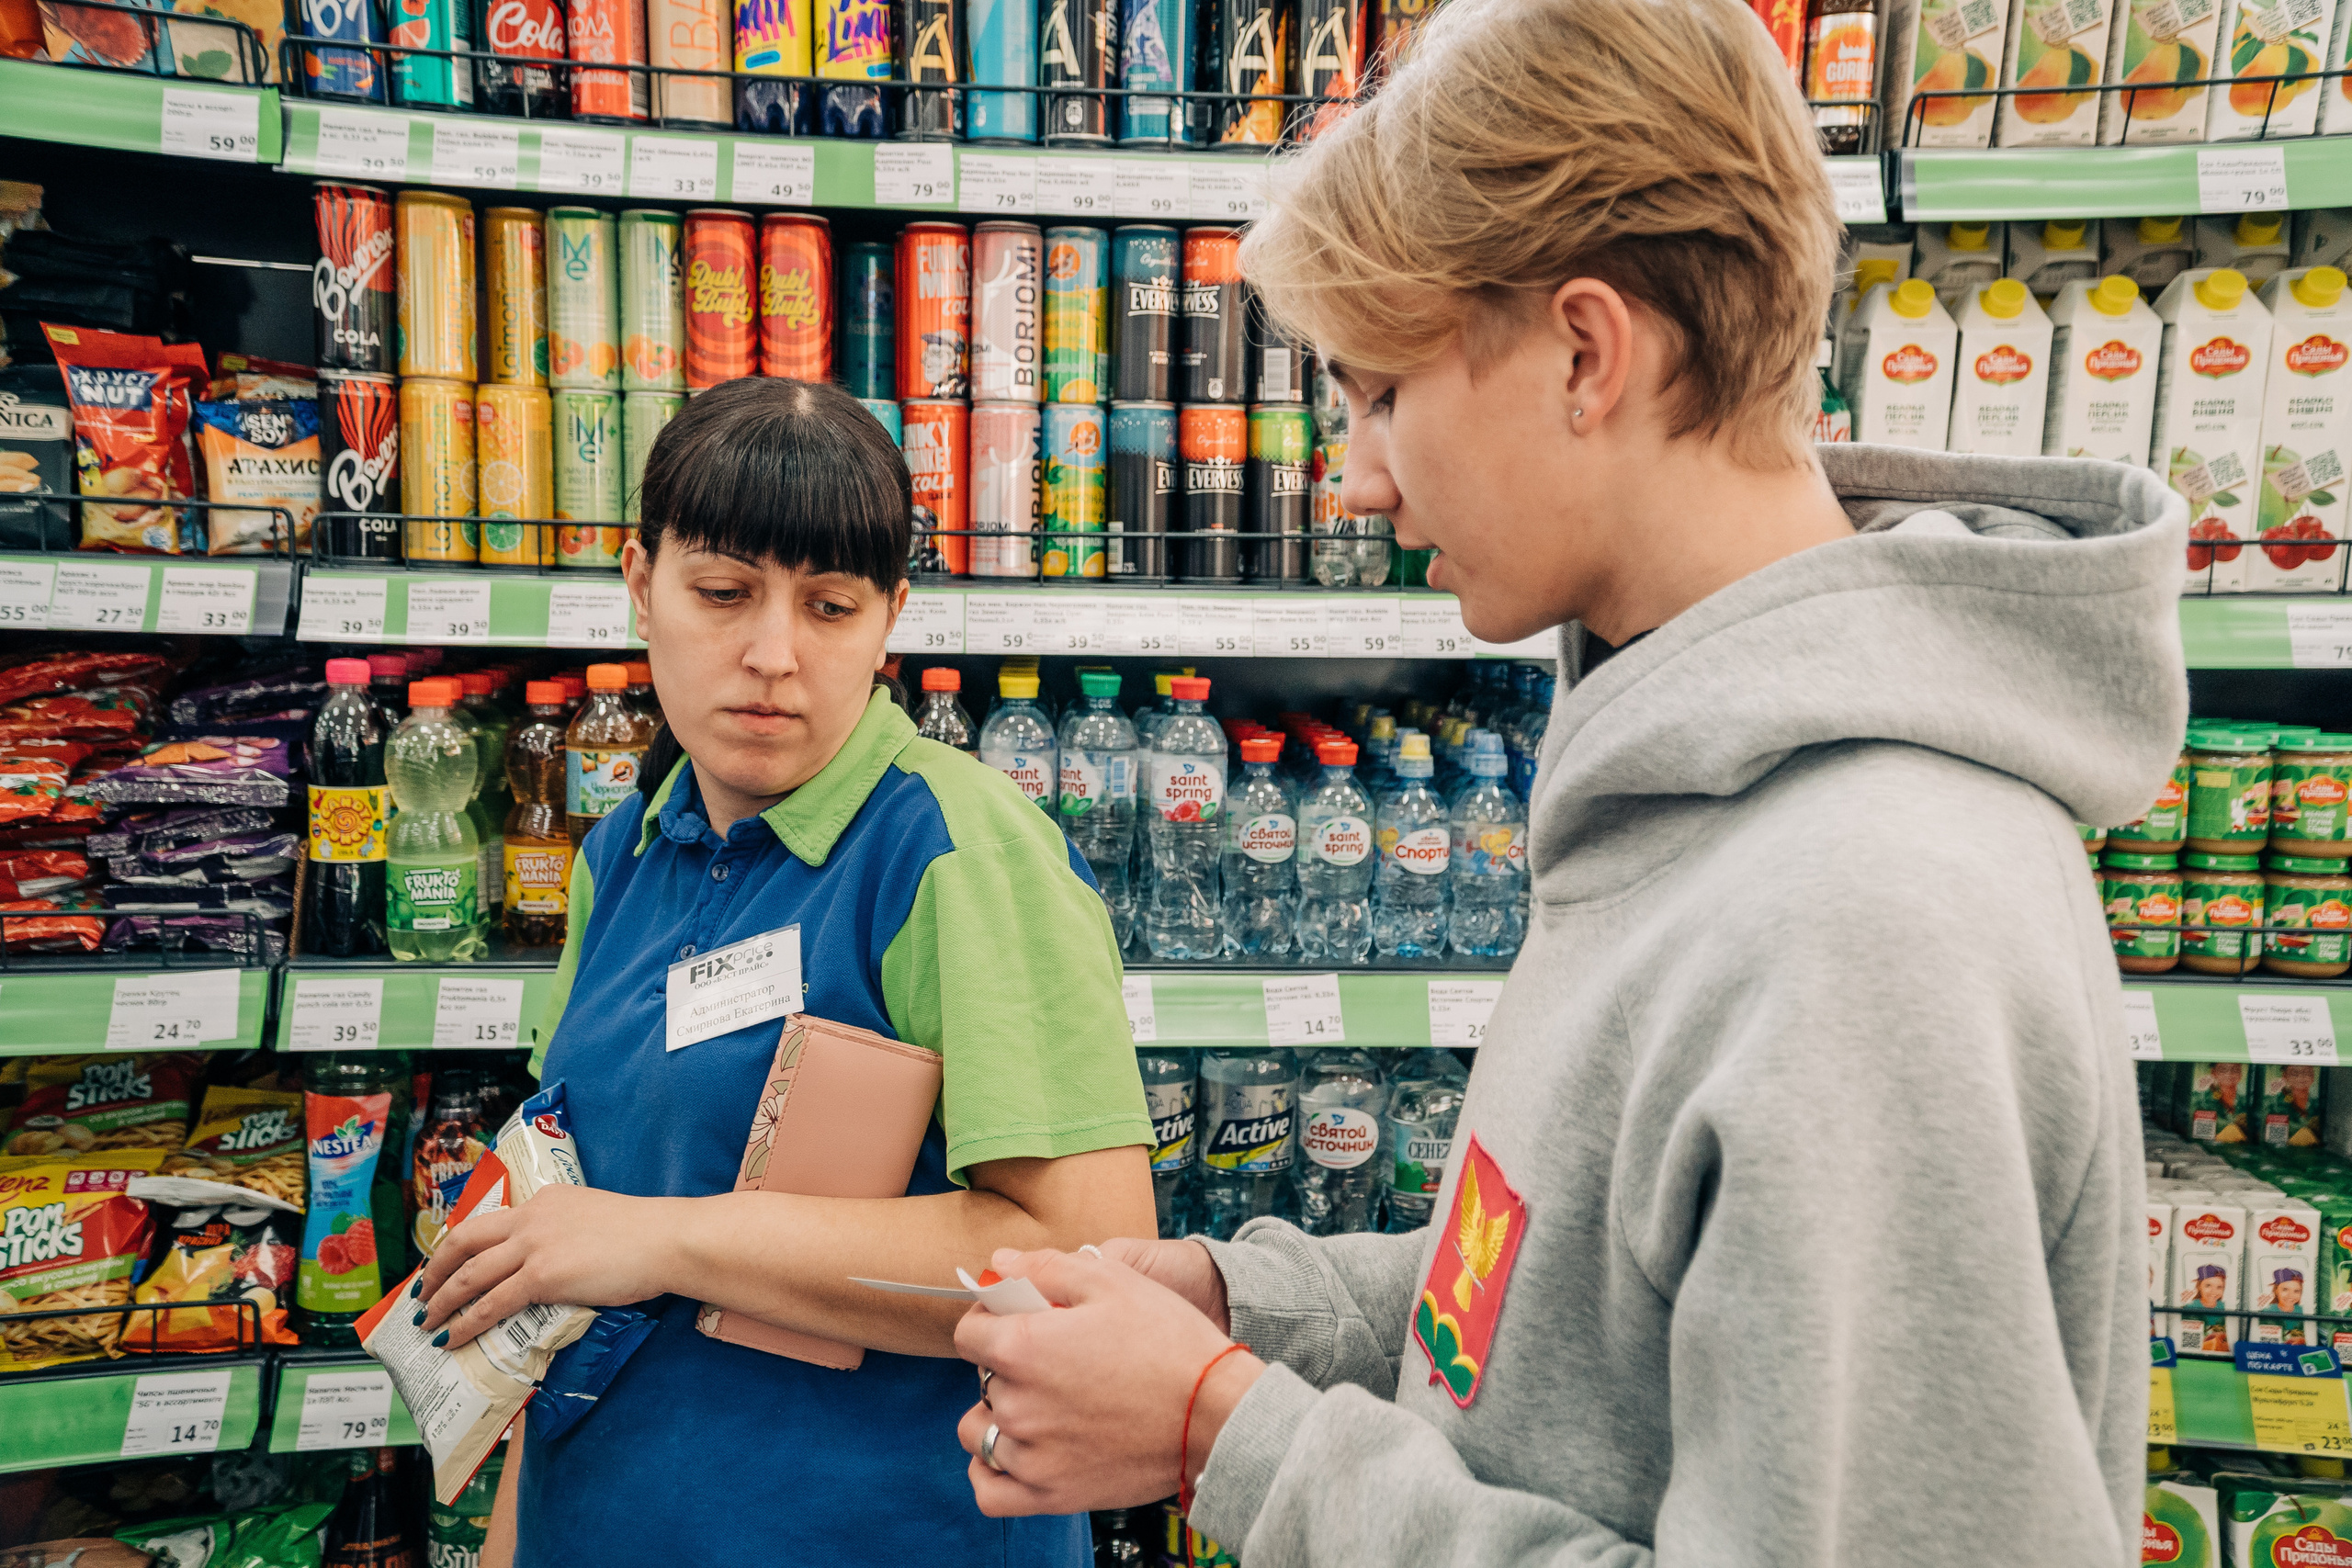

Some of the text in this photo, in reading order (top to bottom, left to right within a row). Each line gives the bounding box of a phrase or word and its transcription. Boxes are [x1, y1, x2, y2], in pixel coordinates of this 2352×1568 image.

[490, 1, 563, 51] Cola
[210, 136, 235, 152] 59
[473, 166, 497, 180] 59
[580, 173, 602, 188] 39
[673, 179, 695, 193] 33
[771, 184, 793, 197] 49
[912, 184, 933, 197] 79
[996, 194, 1016, 207] 79
[1073, 196, 1093, 209] 99
[1151, 198, 1172, 211] 99
[2242, 189, 2266, 205] 79
[1228, 200, 1249, 213] 99
[1014, 244, 1036, 388] BORJOMI
[333, 328, 381, 347] COLA
[79, 384, 144, 406] NUT
[247, 412, 288, 430] SEN
[250, 426, 287, 447] SOY
[1187, 465, 1244, 491] EVERVESS
[358, 518, 397, 534] COLA
[96, 606, 143, 625] 27 50
[202, 610, 248, 627] 33 00
[339, 620, 363, 635] 39
[447, 623, 469, 636] 39
[924, 633, 945, 647] 39
[1002, 634, 1023, 648] 59
[1068, 636, 1088, 649] 39
[1140, 637, 1161, 650] 55
[1216, 637, 1236, 650] 55
[1290, 635, 1327, 650] 55 00
[1364, 637, 1385, 650] 59
[1435, 638, 1456, 652] 39
[1170, 773, 1208, 787] saint
[1165, 785, 1213, 801] spring
[1329, 831, 1361, 842] saint
[1325, 841, 1364, 856] spring
[514, 855, 565, 875] FRUKTO
[404, 869, 461, 893] FRUKTO
[519, 869, 563, 886] MANIA
[410, 885, 458, 902] MANIA
[733, 942, 774, 964] price
[695, 962, 770, 990] ООО «БЭСТ ПРАЙС»
[347, 991, 372, 999] Candy
[690, 983, 775, 1018] Администратор
[676, 995, 791, 1037] Смирнова Екатерина
[1139, 1016, 1153, 1025] 00
[154, 1019, 201, 1040] 24 70
[333, 1021, 378, 1042] 39 50
[475, 1021, 516, 1040] 15 80
[1305, 1015, 1341, 1035] 14 70
[1467, 1023, 1487, 1038] 24
[2289, 1039, 2314, 1056] 33
[84, 1059, 135, 1084] POM
[66, 1073, 153, 1111] STICKS
[218, 1123, 299, 1151] STICKS
[1219, 1114, 1290, 1147] Active
[310, 1135, 377, 1156] NESTEA
[5, 1201, 66, 1239] POM
[137, 1386, 218, 1399] Чипсы пшеничные
[162, 1396, 223, 1407] ассортименте
[170, 1419, 220, 1443] 14 70
[341, 1417, 387, 1440] 79 00
[2322, 1436, 2342, 1450] 23
[2294, 1537, 2338, 1554] Сады
[2280, 1547, 2352, 1567] Придонья
